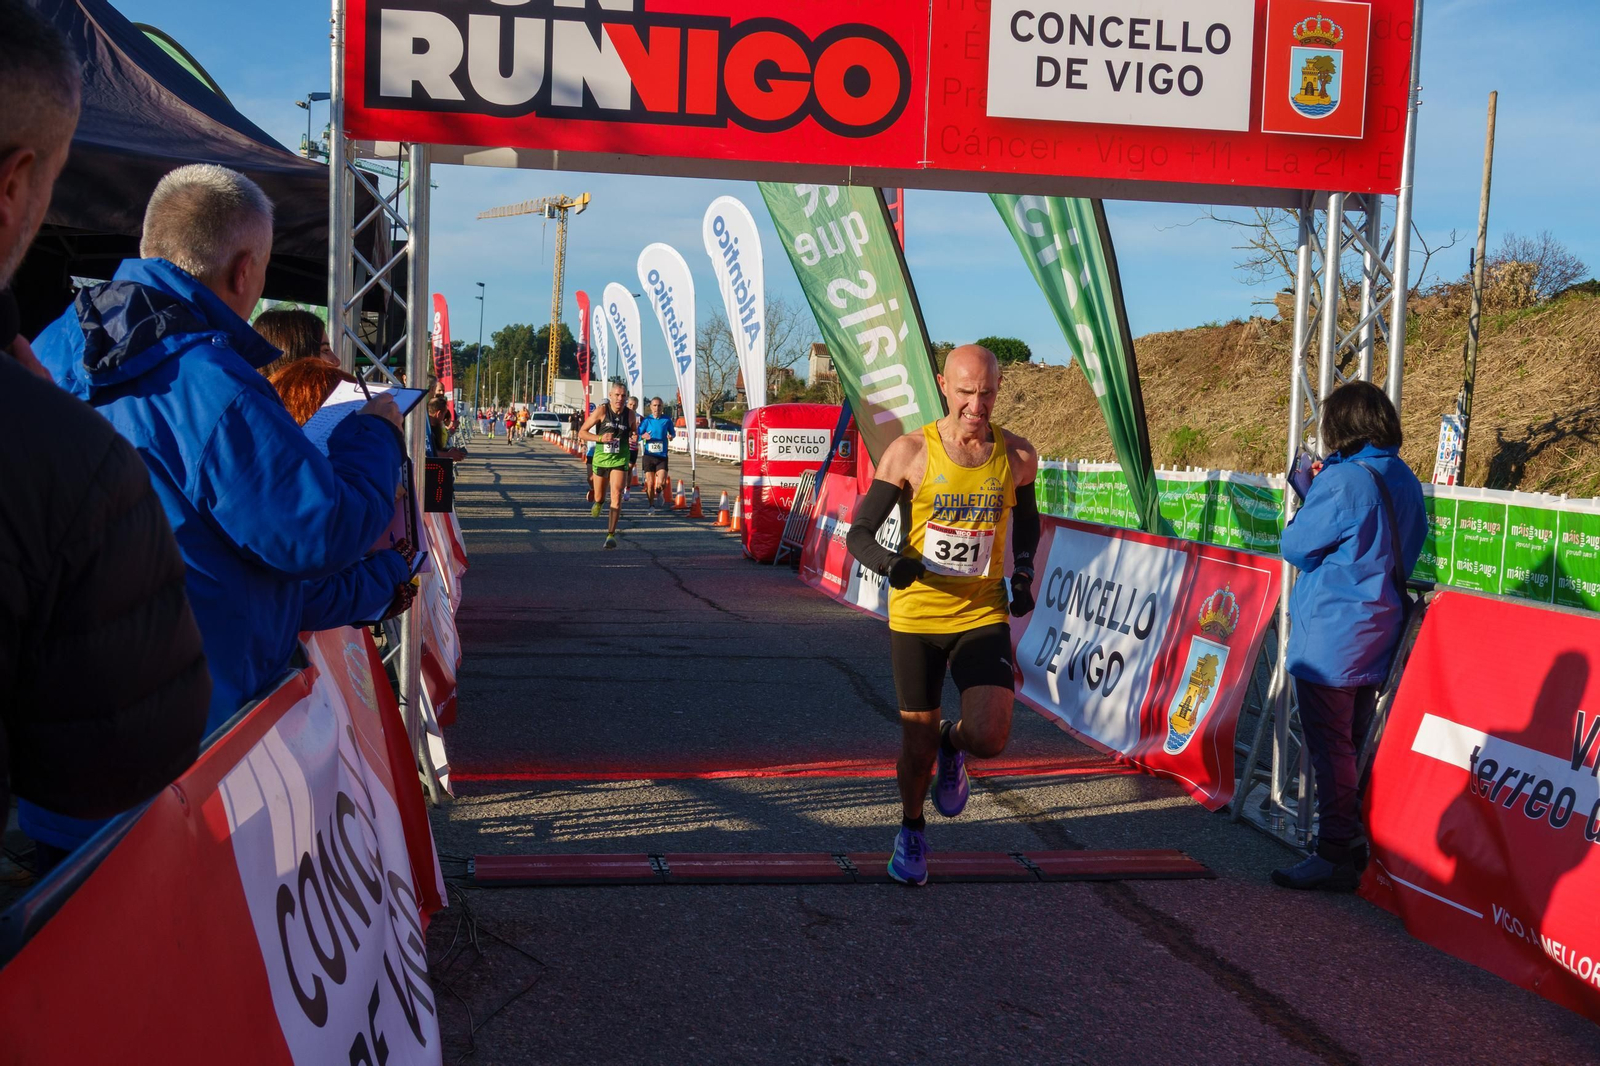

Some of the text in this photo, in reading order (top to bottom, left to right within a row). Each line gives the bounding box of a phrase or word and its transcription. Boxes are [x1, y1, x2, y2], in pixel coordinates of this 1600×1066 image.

[1010, 10, 1231, 55] CONCELLO
[1036, 56, 1205, 97] DE VIGO
[941, 125, 1062, 161] Cáncer
[1095, 136, 1169, 173] Vigo
[1185, 139, 1232, 170] +11
[1264, 143, 1300, 174] La
[1314, 147, 1347, 176] 21
[772, 435, 826, 444] CONCELLO
[778, 446, 820, 454] DE VIGO
[933, 493, 1004, 507] ATHLETICS
[933, 508, 1001, 522] SAN LÁZARO
[935, 540, 980, 562] 321
[1045, 566, 1156, 641] CONCELLO
[1034, 626, 1124, 698] DE VIGO
[1469, 745, 1577, 829] terreo
[1491, 903, 1530, 944] VIGO,
